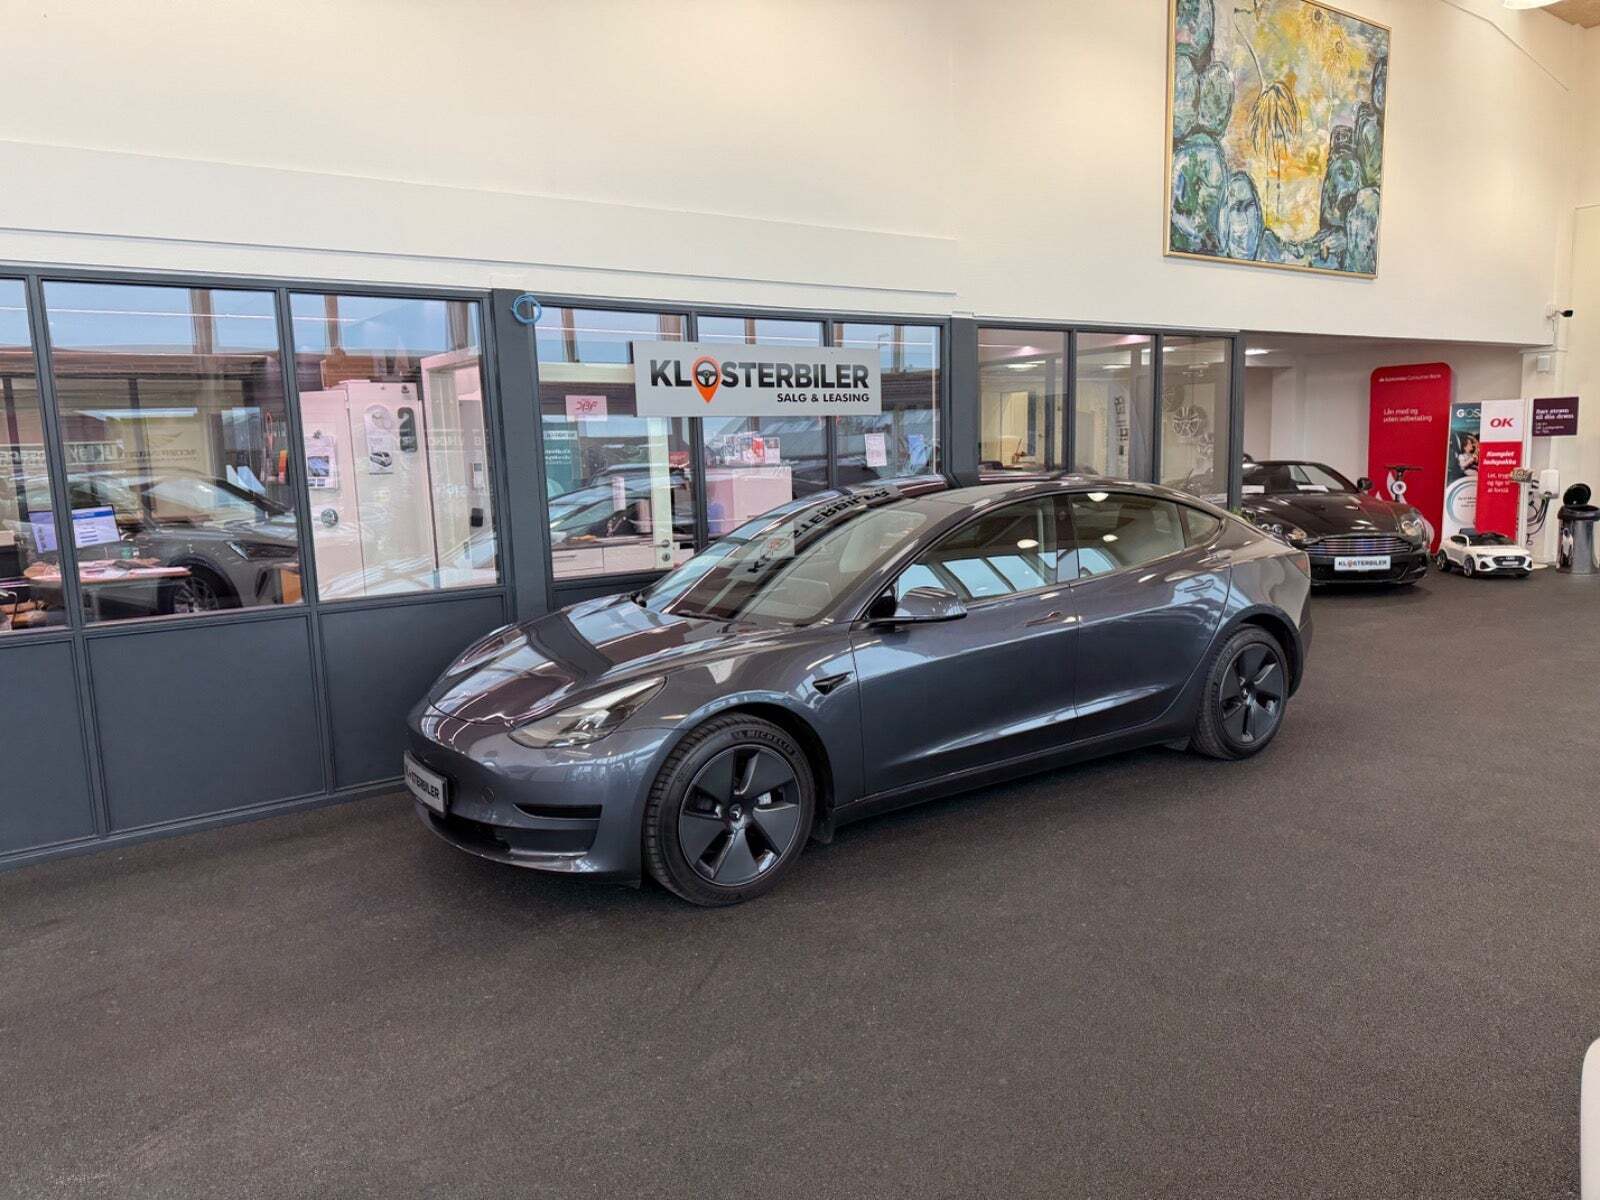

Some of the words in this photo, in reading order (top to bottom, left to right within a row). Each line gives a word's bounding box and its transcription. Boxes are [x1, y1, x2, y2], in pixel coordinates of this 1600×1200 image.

[650, 359, 870, 389] KLOSTERBILER
[777, 393, 807, 403] SALG
[811, 393, 819, 402] &
[823, 393, 870, 403] LEASING
[1410, 408, 1419, 416] og
[1456, 408, 1481, 418] GOS
[1490, 418, 1514, 428] OK
